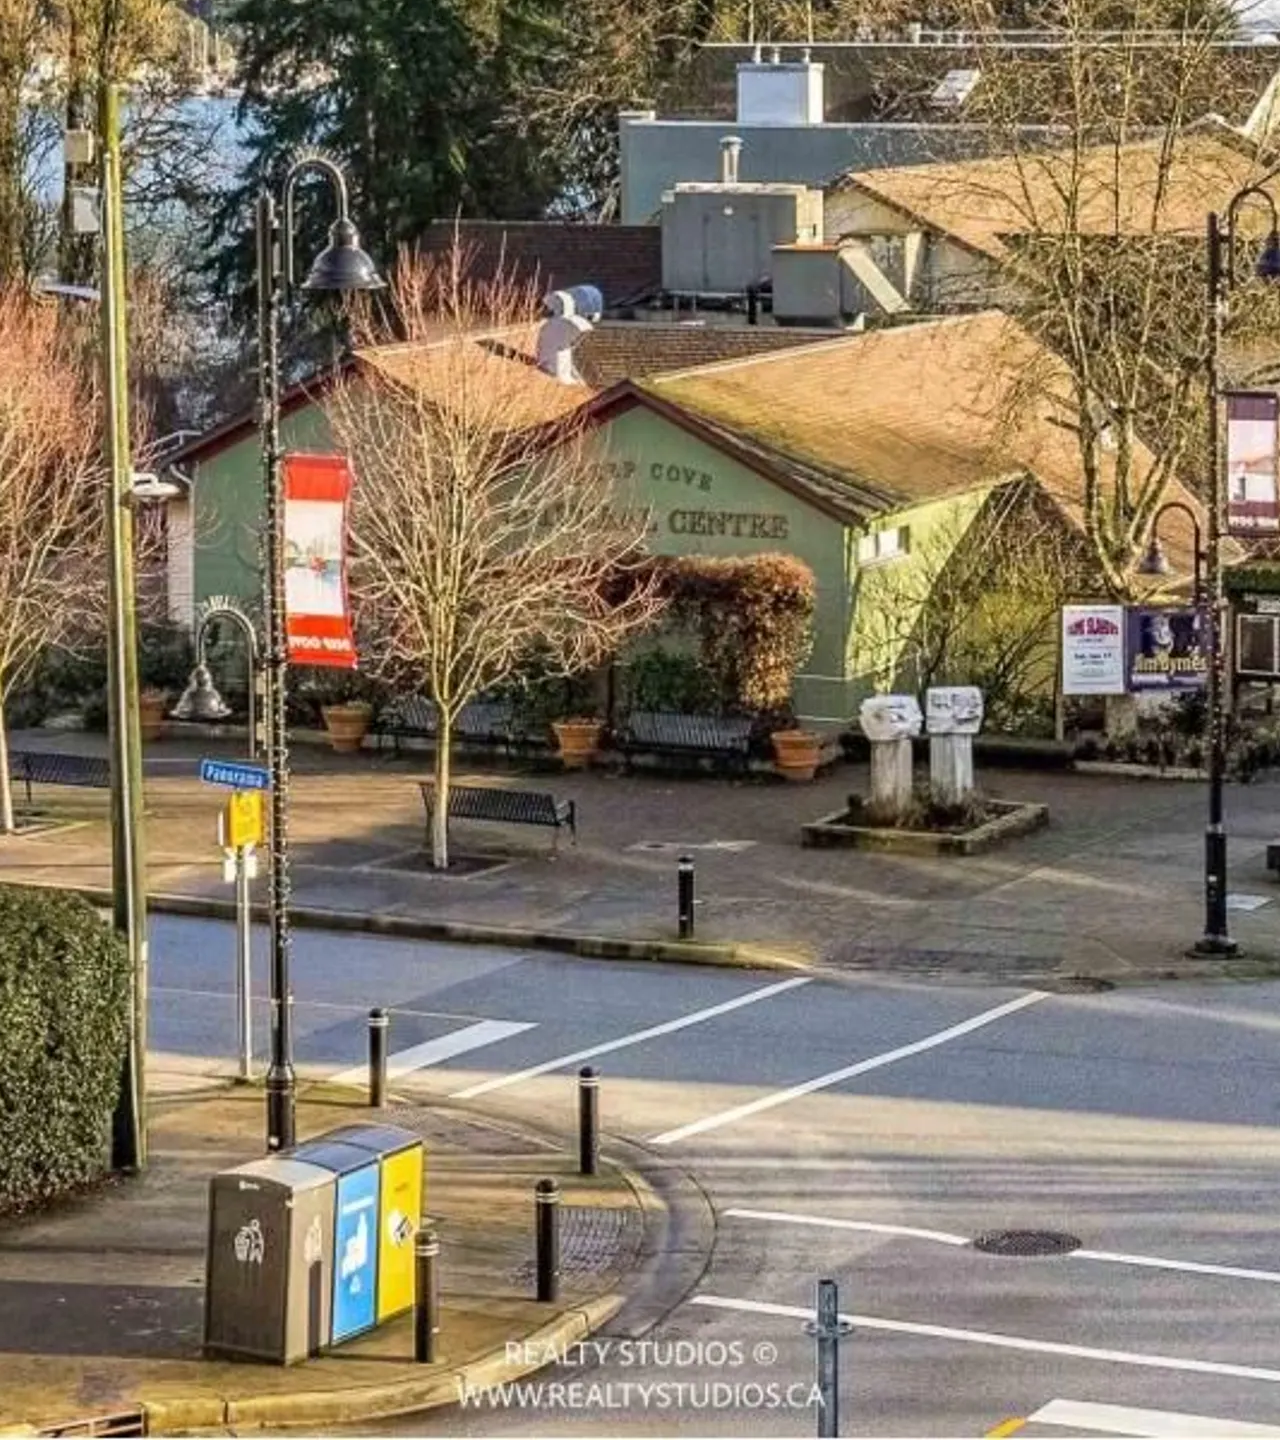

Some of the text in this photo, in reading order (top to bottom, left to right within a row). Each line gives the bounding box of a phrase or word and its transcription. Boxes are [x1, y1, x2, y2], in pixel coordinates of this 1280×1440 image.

[651, 462, 713, 492] COVE
[668, 508, 790, 540] CENTRE
[205, 764, 263, 788] Panorama
